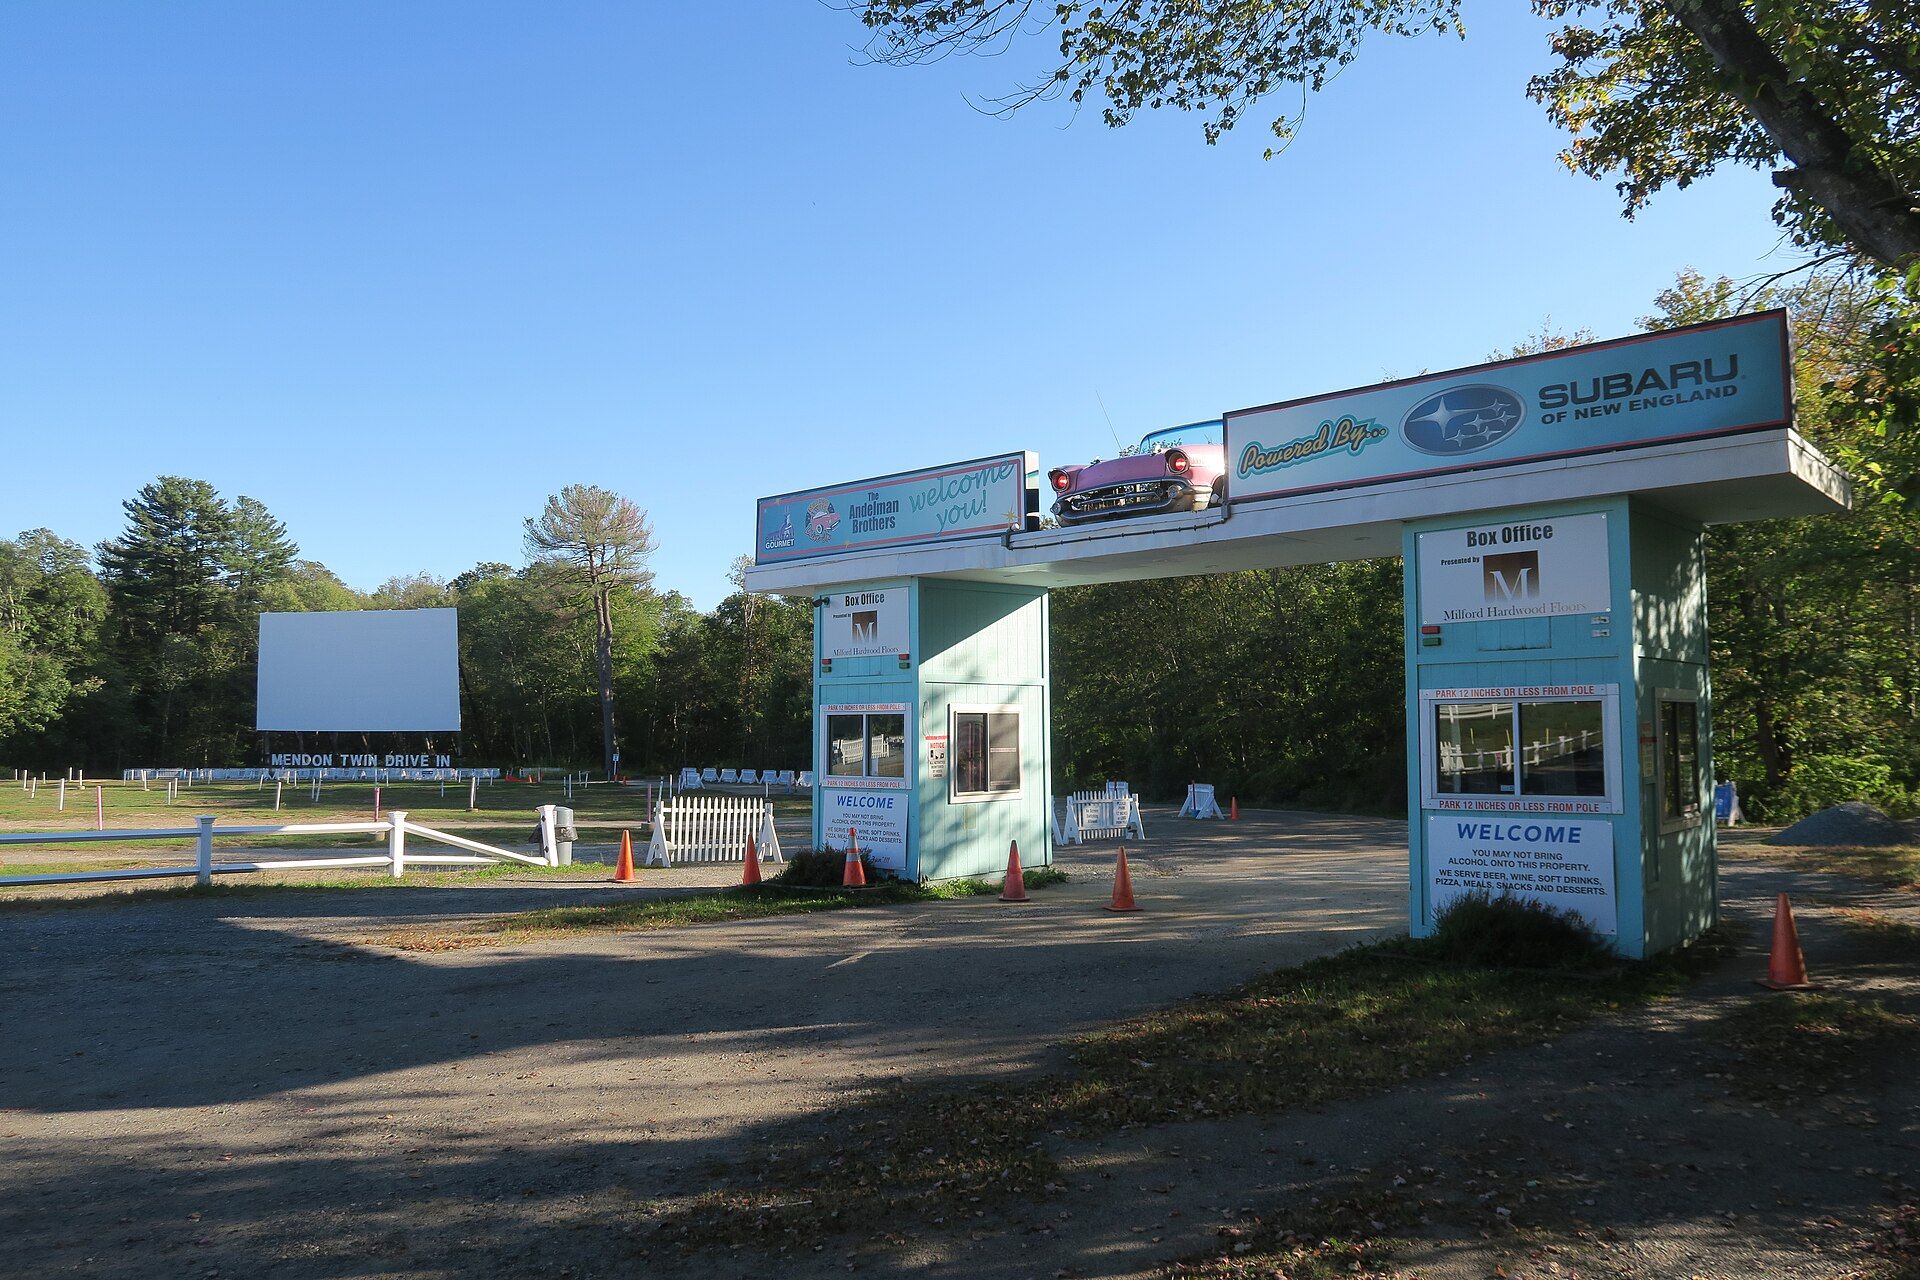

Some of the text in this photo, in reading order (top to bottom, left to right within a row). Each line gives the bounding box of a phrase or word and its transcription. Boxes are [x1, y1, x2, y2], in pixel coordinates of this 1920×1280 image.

[1539, 354, 1738, 409] SUBARU
[1541, 385, 1738, 424] OF NEW ENGLAND
[1240, 424, 1329, 474] Powered
[909, 459, 1015, 512] welcome
[868, 492, 879, 501] The
[849, 500, 899, 519] Andelman
[936, 489, 987, 537] you!
[852, 516, 895, 534] Brothers
[765, 539, 794, 549] GOURMET
[1467, 524, 1553, 547] Box Office
[1440, 557, 1472, 565] Presented
[845, 592, 885, 606] Box Office
[1444, 602, 1586, 621] Milford Hardwood Floors
[853, 646, 880, 655] Hardwood
[1435, 685, 1595, 698] PARK 12 INCHES OR LESS FROM POLE
[271, 753, 450, 767] MENDON TWIN DRIVE IN
[837, 795, 894, 809] WELCOME
[1439, 801, 1600, 812] PARK 12 INCHES OR LESS FROM POLE
[1457, 823, 1582, 843] WELCOME
[1472, 849, 1563, 860] YOU MAY NOT BRING
[1448, 857, 1591, 872] ALCOHOL ONTO THIS PROPERTY.
[1439, 869, 1602, 886] WE SERVE BEER, WINE, SOFT DRINKS,
[1435, 878, 1462, 888] PIZZA,
[1496, 882, 1532, 892] SNACKS
[1534, 884, 1554, 893] AND
[1556, 885, 1608, 896] DESSERTS.
